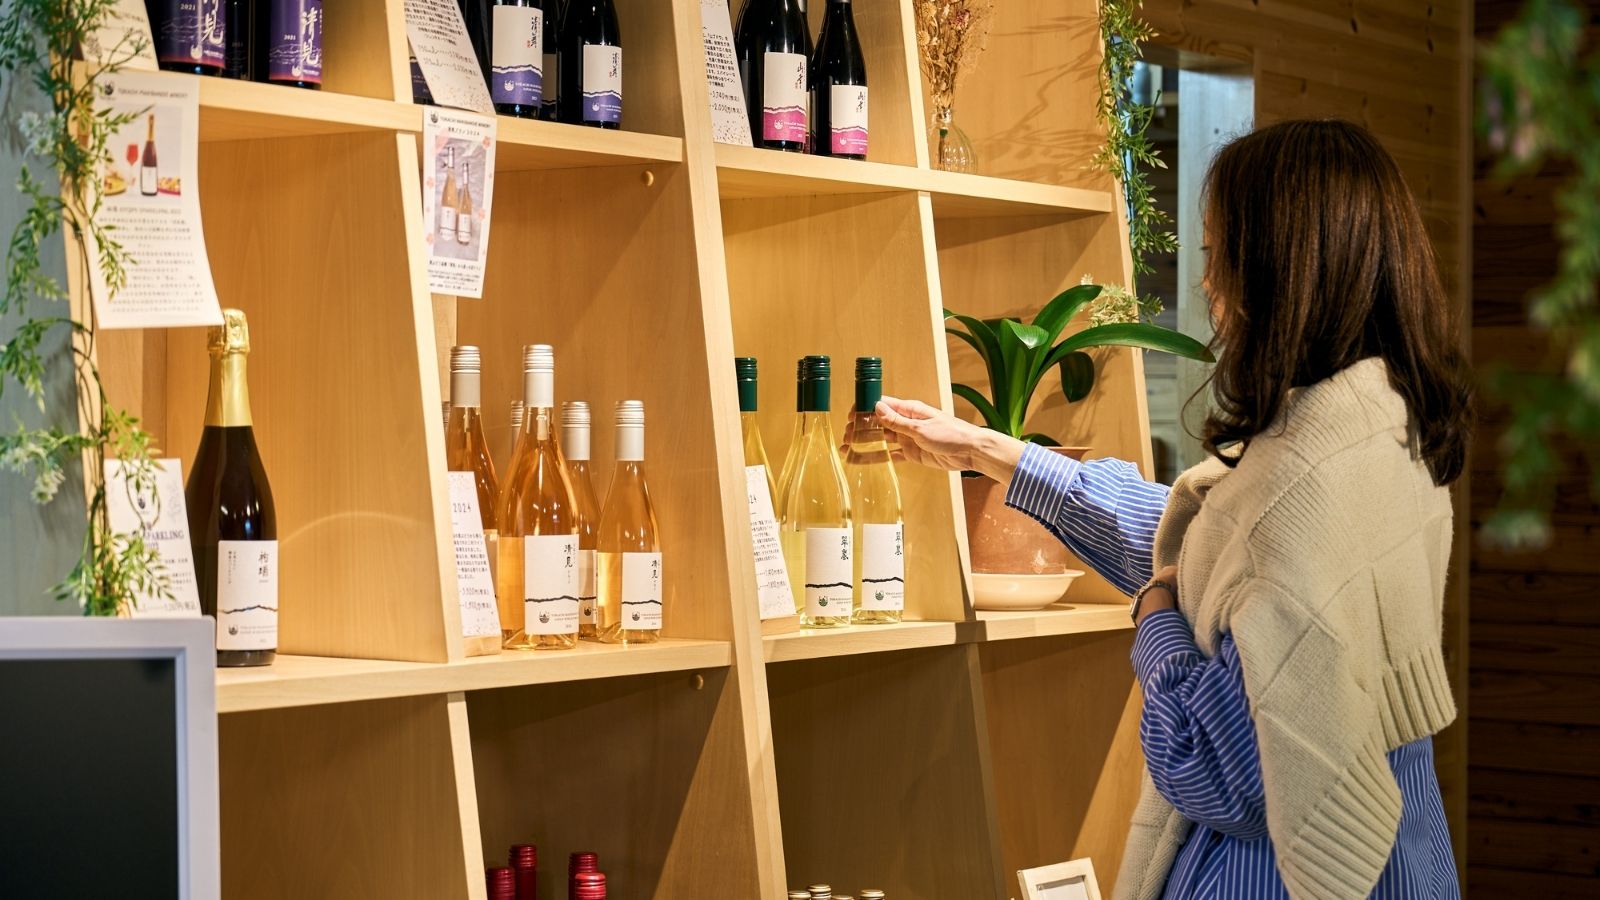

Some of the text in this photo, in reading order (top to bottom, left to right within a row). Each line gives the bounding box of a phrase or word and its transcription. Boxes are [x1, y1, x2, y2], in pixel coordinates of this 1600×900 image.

[180, 3, 196, 11] 2021
[300, 6, 319, 65] 清見
[452, 502, 471, 513] 2024
